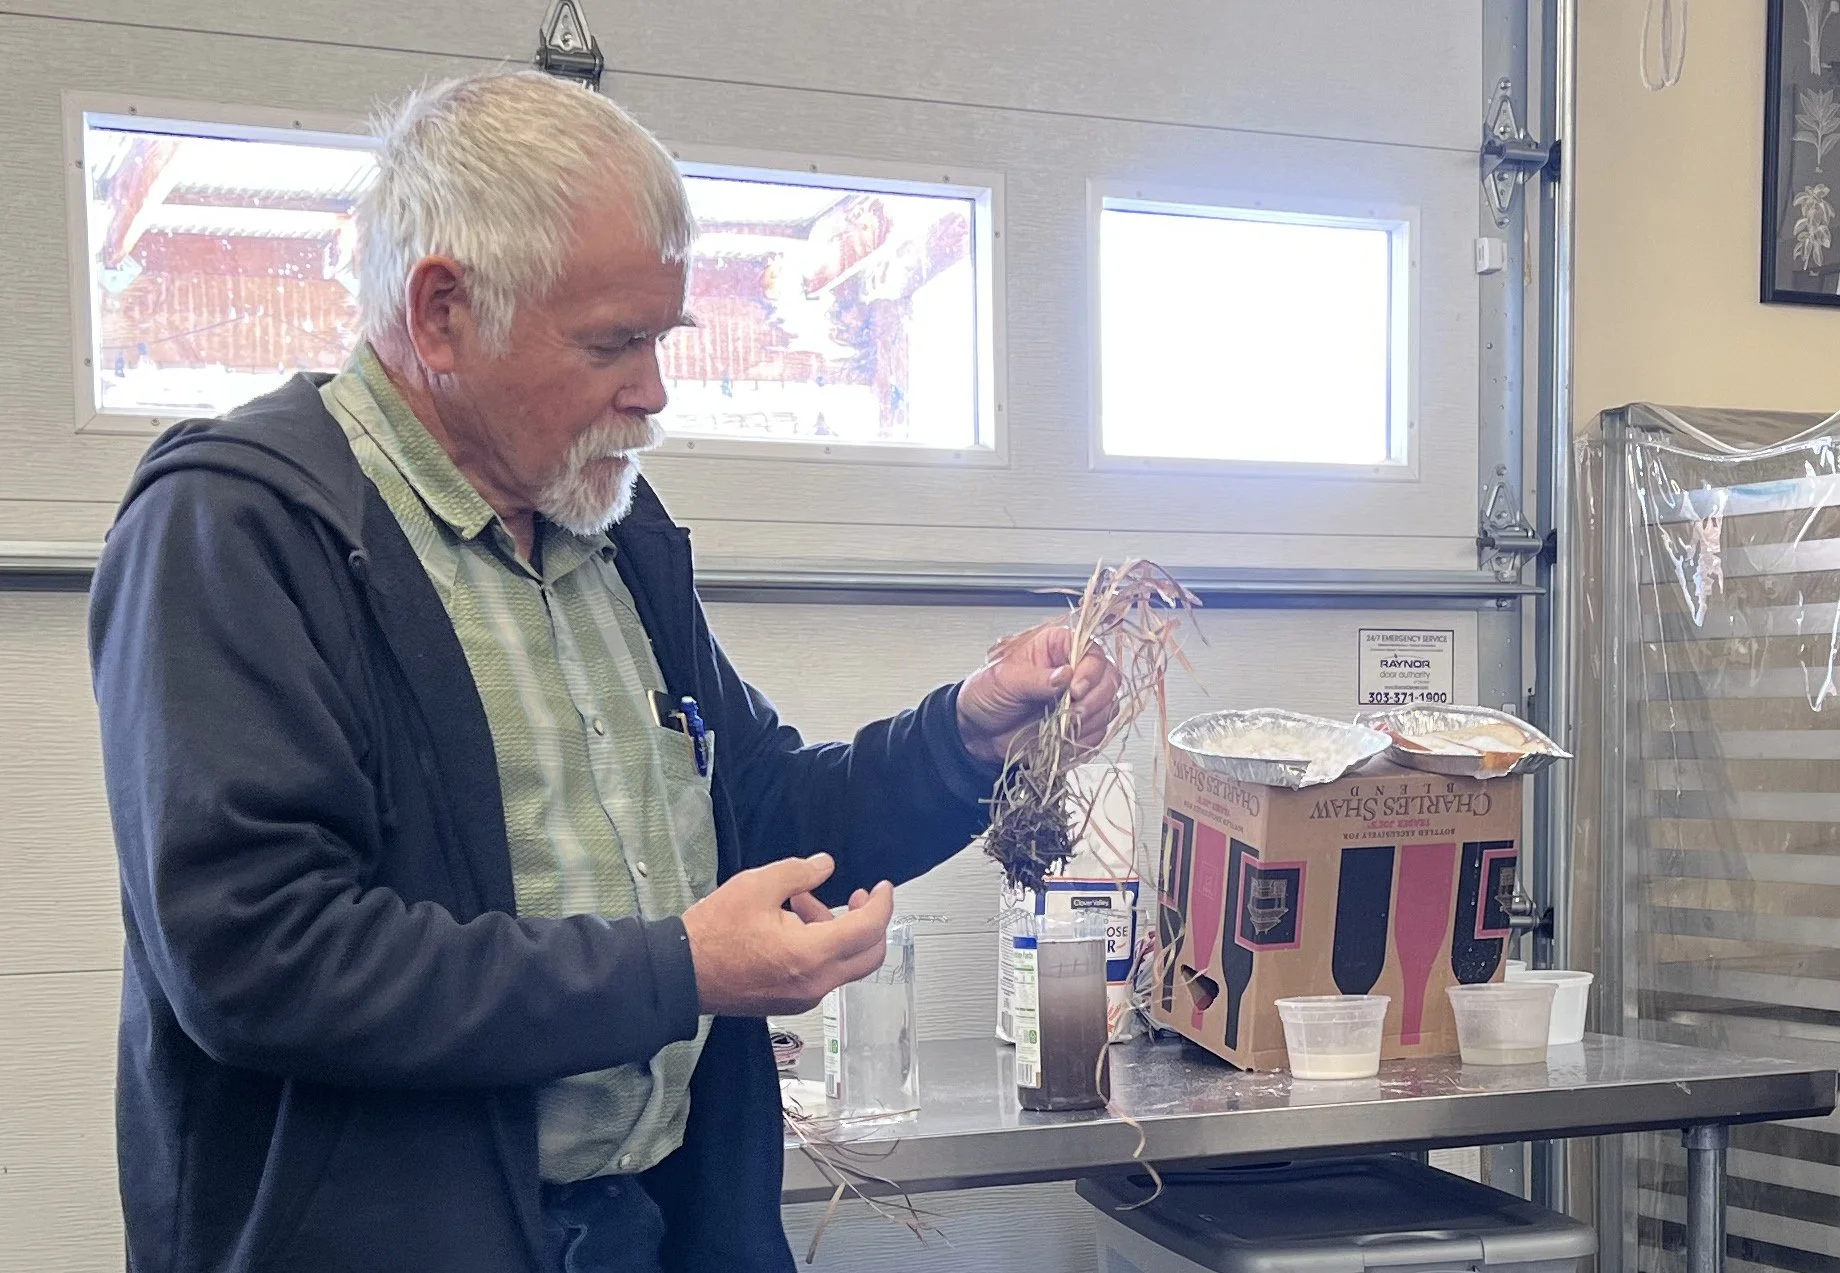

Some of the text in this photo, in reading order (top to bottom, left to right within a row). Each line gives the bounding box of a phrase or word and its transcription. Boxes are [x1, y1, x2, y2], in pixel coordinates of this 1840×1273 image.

[1366, 634, 1448, 643] 24/7 EMERGENCY SERVICE
[1380, 659, 1431, 669] RAYNOR
[1379, 670, 1431, 680] door authority
[1368, 692, 1447, 704] 303-371-1900
[1351, 782, 1455, 797] BLEND
[1206, 775, 1260, 817] CHARLES
[1309, 792, 1493, 821] CHARLES SHAW
[1343, 828, 1456, 840] BOTTLED EXCLUSIVELY FOR
